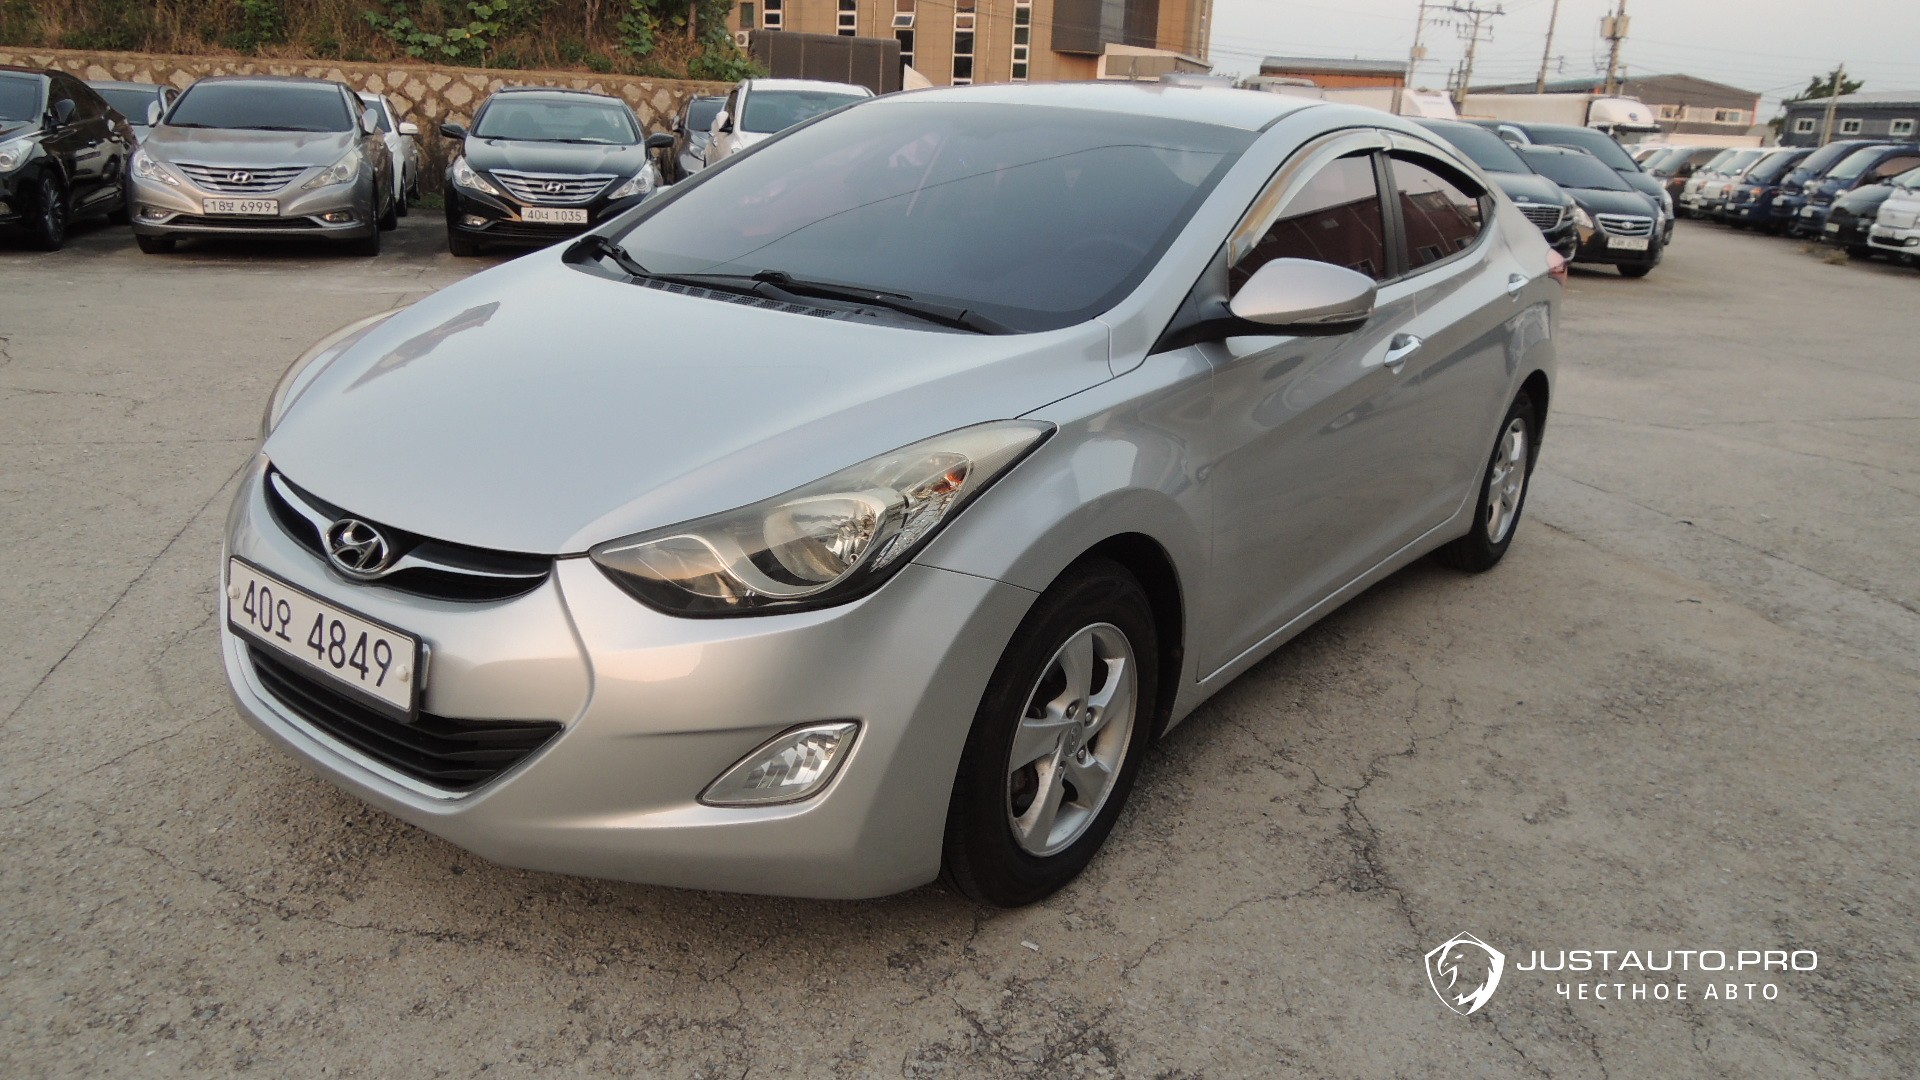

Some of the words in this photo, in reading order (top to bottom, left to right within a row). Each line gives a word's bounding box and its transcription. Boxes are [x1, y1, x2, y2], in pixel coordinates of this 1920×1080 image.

[240, 201, 271, 212] 6999
[554, 211, 582, 221] 1035
[243, 580, 292, 643] 40오
[307, 612, 393, 687] 4849
